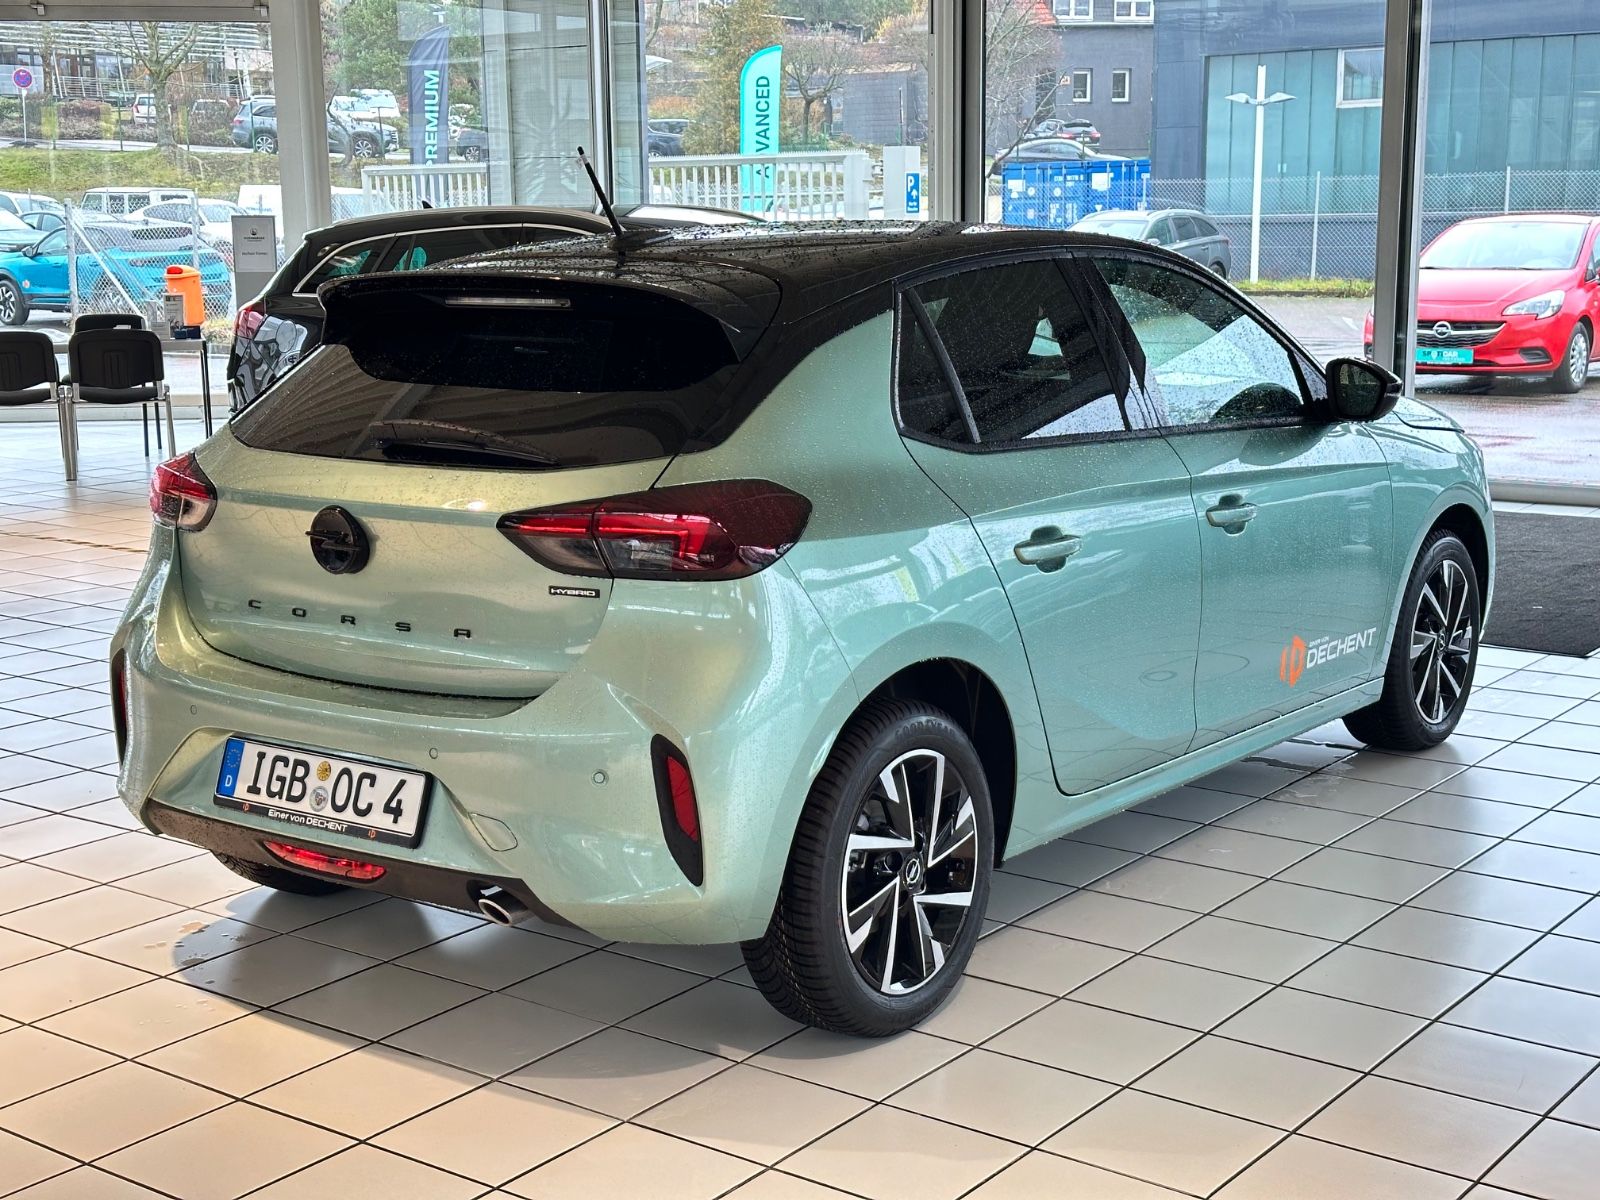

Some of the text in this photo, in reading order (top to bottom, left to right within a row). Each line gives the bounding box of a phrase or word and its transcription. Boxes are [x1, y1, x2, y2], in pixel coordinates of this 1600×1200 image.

[755, 76, 770, 179] AVANCED
[907, 176, 915, 192] P
[551, 588, 596, 597] HYBRID
[1306, 627, 1377, 669] DECHENT
[224, 775, 233, 787] D
[247, 751, 406, 824] IGB OC 4
[267, 809, 348, 833] Einer von DECHENT
